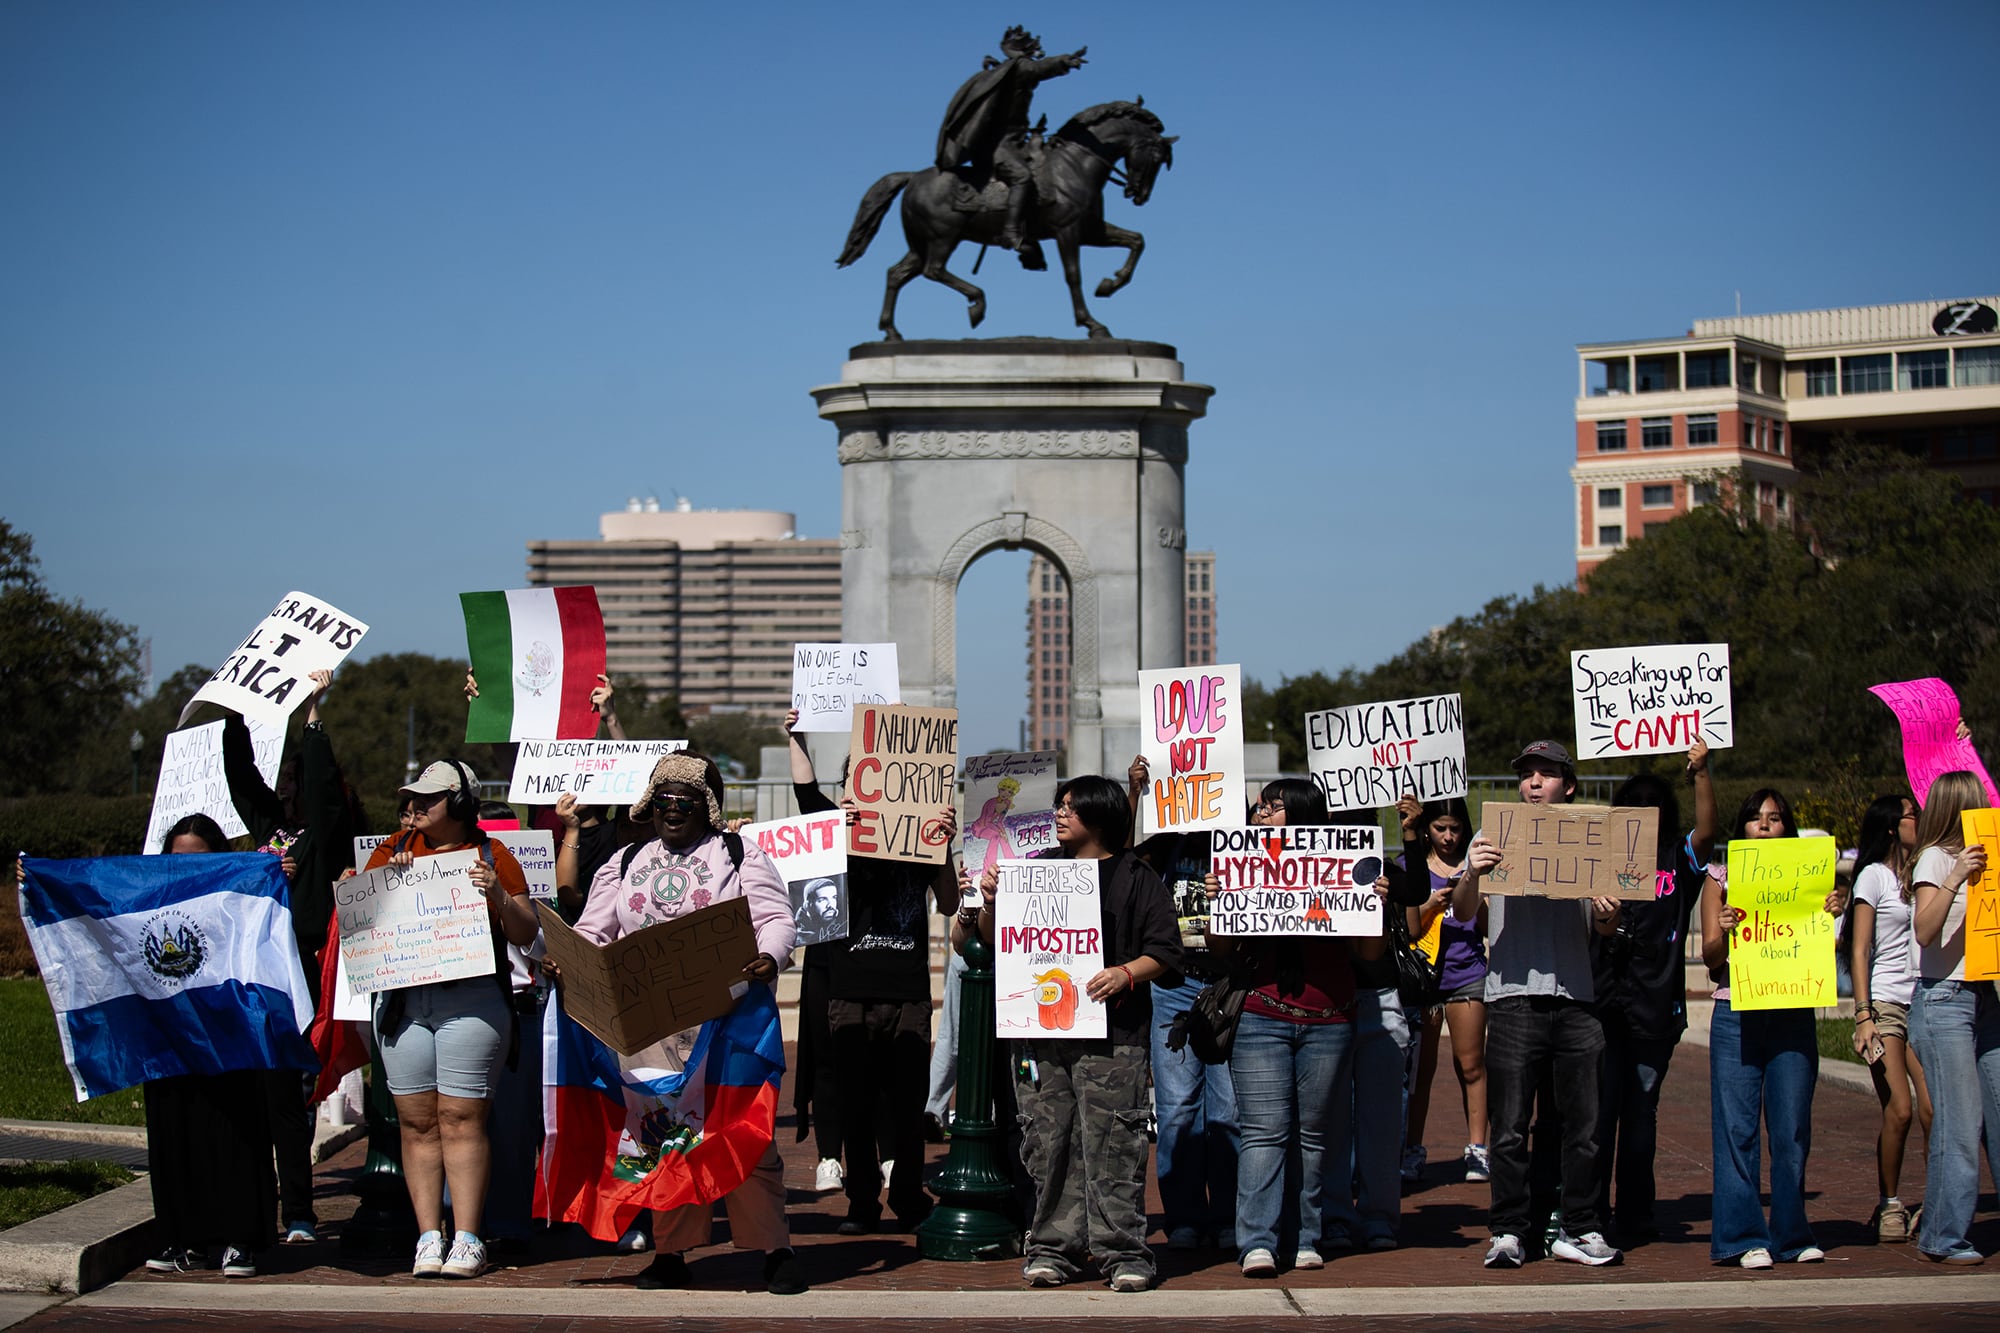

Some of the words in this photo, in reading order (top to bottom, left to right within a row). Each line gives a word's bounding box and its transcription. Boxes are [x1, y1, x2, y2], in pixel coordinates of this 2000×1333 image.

[271, 599, 362, 650] GRANTS
[798, 649, 812, 668] NO
[815, 650, 840, 669] ONE
[853, 650, 868, 668] IS
[1576, 656, 1667, 693] Speaking
[1670, 666, 1692, 689] up
[1697, 652, 1728, 682] for
[210, 654, 298, 705] ERICA
[806, 671, 863, 687] ILLEGAL
[795, 693, 807, 709] ON
[811, 693, 847, 712] STOLEN
[1154, 675, 1226, 743] LOVE
[1583, 692, 1618, 720] The
[1628, 686, 1665, 714] kids
[1671, 686, 1712, 706] who
[863, 709, 958, 754] INHUMANE
[1310, 696, 1461, 750] EDUCATION
[171, 728, 214, 761] WHEN
[523, 742, 543, 758] NO
[547, 743, 595, 757] DECENT
[596, 743, 641, 756] HUMAN
[645, 743, 669, 756] HAS
[674, 742, 681, 751] A
[1170, 737, 1216, 777] NOT
[1372, 739, 1418, 768] NOT
[575, 758, 617, 771] HEART
[525, 774, 569, 794] MADE
[574, 774, 594, 792] OF
[598, 771, 639, 793] ICE
[156, 787, 195, 813] AMONG
[1155, 772, 1224, 828] HATE
[851, 810, 933, 859] EVIL
[1017, 824, 1052, 847] ICE
[1281, 828, 1320, 850] LET
[1323, 829, 1374, 850] THEM
[1529, 818, 1602, 845] ICE
[631, 854, 713, 887] GRATEFUL
[1000, 862, 1094, 895] THERE'S
[1213, 856, 1353, 887] HYPNOTIZE
[1529, 857, 1602, 889] OUT
[1731, 848, 1783, 883] This
[1796, 857, 1828, 878] isn't
[336, 873, 377, 906] God
[431, 860, 473, 880] Ameri
[1756, 882, 1799, 904] about
[342, 909, 373, 931] Chile
[416, 892, 452, 916] Uruguay
[450, 888, 486, 913] Paraguay
[1022, 895, 1069, 927] AN
[1216, 891, 1248, 912] YOU
[1256, 892, 1295, 910] INTO
[1299, 891, 1377, 912] THINKING
[370, 929, 394, 940] Peru
[397, 925, 433, 936] Ecuador
[1213, 913, 1249, 933] THIS
[1250, 913, 1269, 933] IS
[1271, 915, 1337, 933] NORMAL
[1733, 908, 1794, 949] Politics
[1804, 911, 1830, 936] it's
[396, 937, 432, 951] Guyana
[1001, 926, 1099, 954] IMPOSTER
[1761, 940, 1801, 959] about
[384, 953, 419, 965] Honduras
[354, 980, 387, 994] United
[1735, 964, 1824, 1002] Humanity
